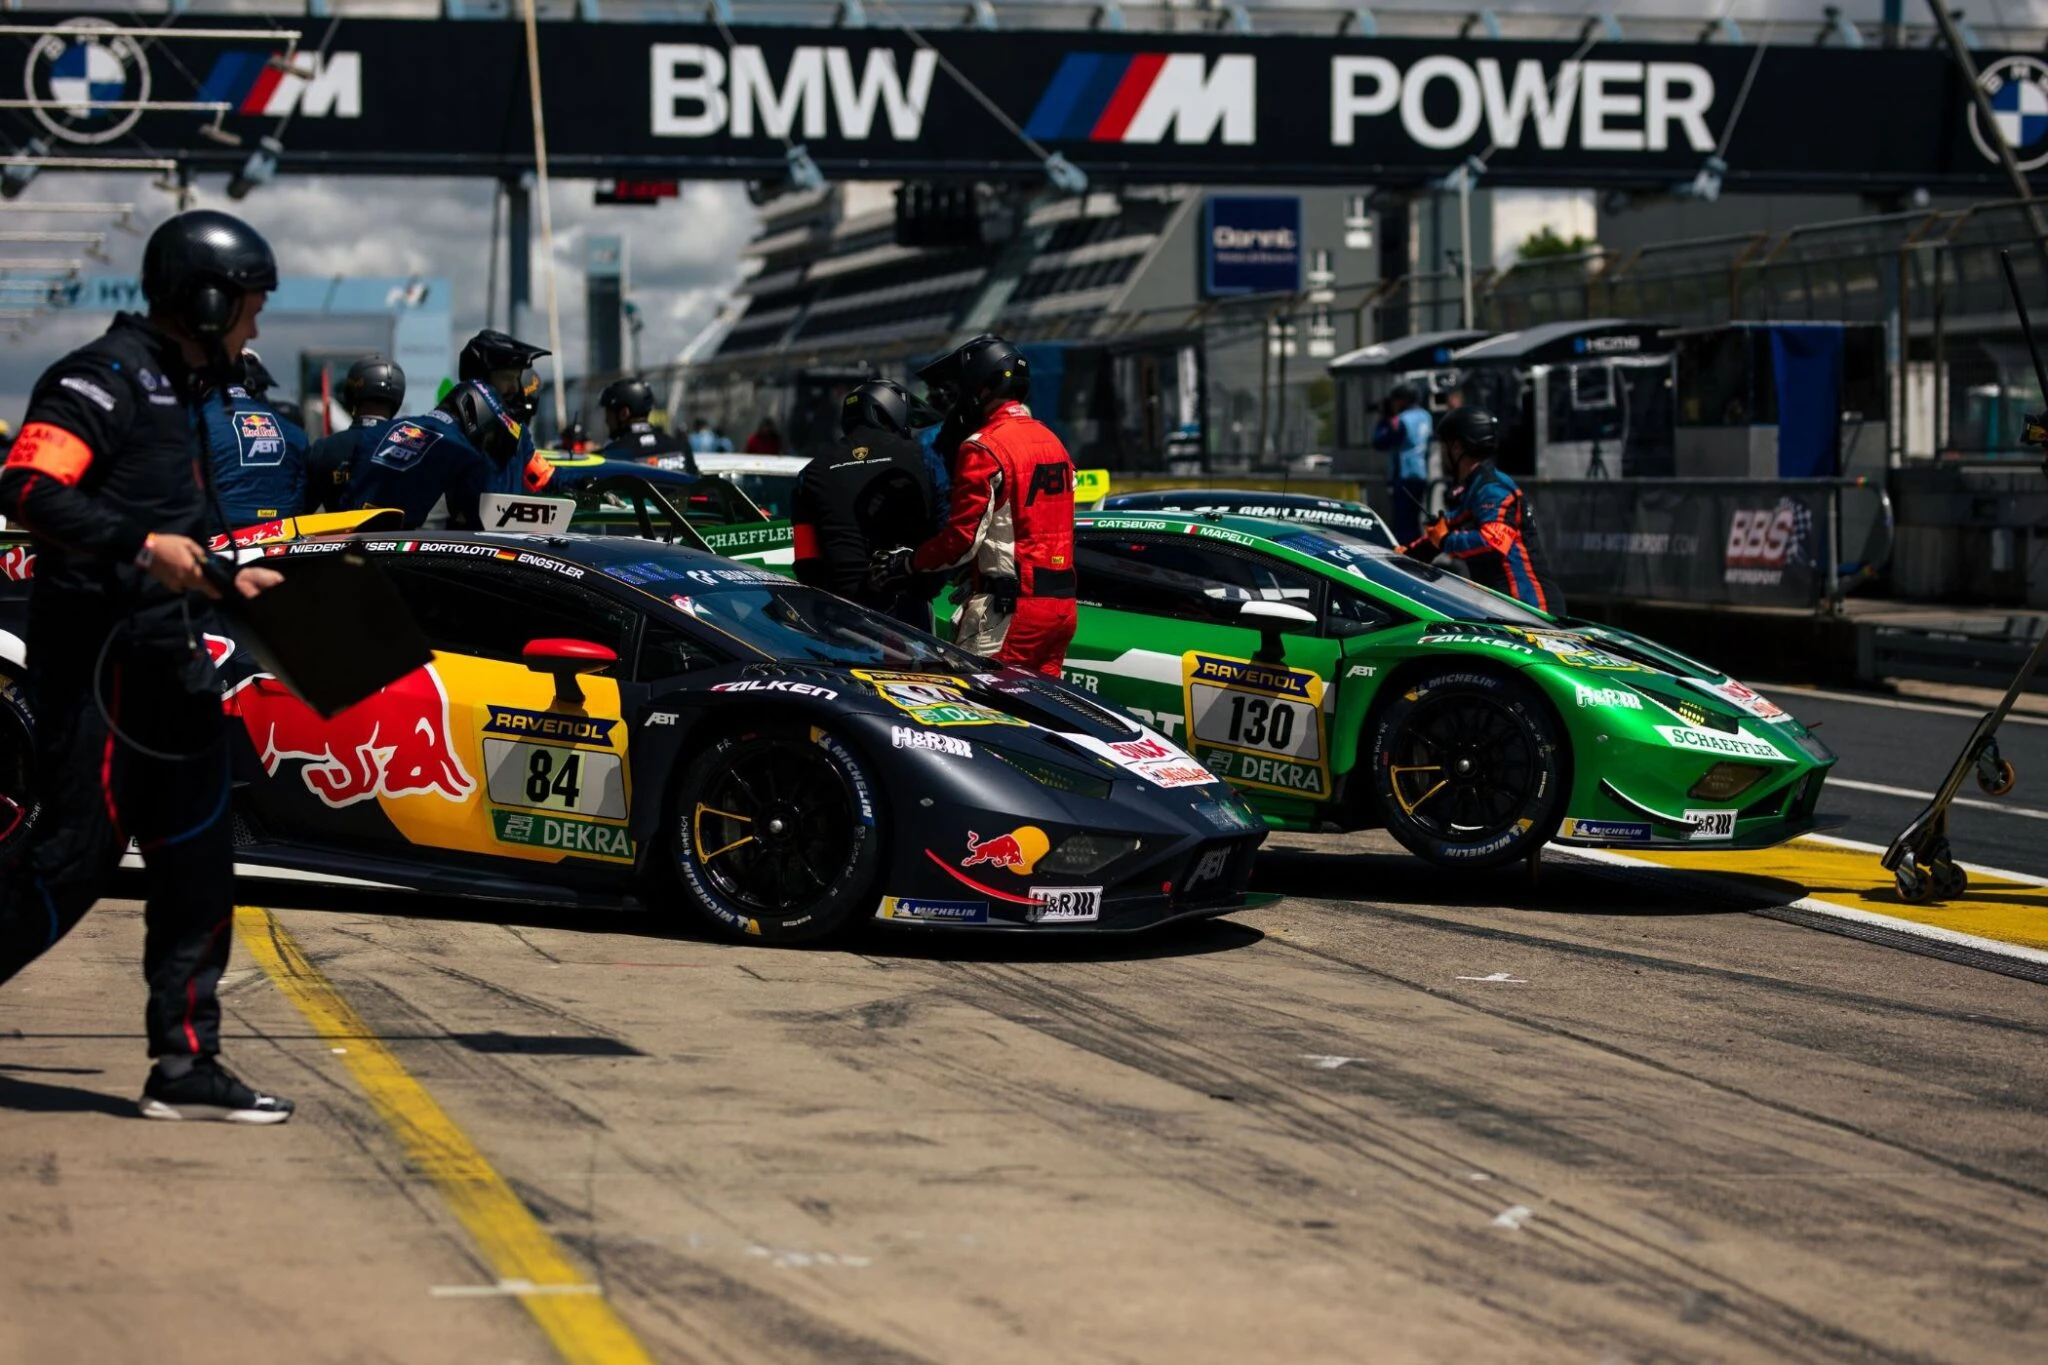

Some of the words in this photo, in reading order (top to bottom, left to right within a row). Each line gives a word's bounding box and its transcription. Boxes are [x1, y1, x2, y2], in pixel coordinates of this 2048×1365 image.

[650, 43, 939, 141] BMW
[1329, 54, 1717, 152] POWER
[247, 440, 280, 458] ABT
[496, 502, 558, 527] ABT
[703, 526, 794, 549] CHAEFFLER
[1097, 519, 1166, 530] CATSBURG
[1200, 527, 1254, 546] MAPELLI
[420, 543, 499, 557] BORTOLOTTI
[517, 554, 585, 579] ENGSTLER
[1418, 634, 1533, 655] FALKEN
[1203, 662, 1300, 691] RAVENOL
[1346, 665, 1376, 678] ABT
[1428, 673, 1497, 689] MICHELIN
[711, 679, 840, 701] FALKEN
[495, 713, 603, 739] RAVENOL
[644, 712, 679, 727] ABT
[1228, 696, 1295, 750] 130
[1672, 728, 1779, 758] SCHAEFFLER
[526, 749, 580, 808] 84
[831, 744, 873, 818] MICHELIN
[1241, 756, 1321, 792] DEKRA
[543, 819, 630, 856] DEKRA
[1590, 827, 1643, 837] MICHELIN
[1445, 837, 1512, 858] MICHELIN
[681, 860, 735, 923] MICHELIN
[913, 906, 977, 918] MICHELIN
